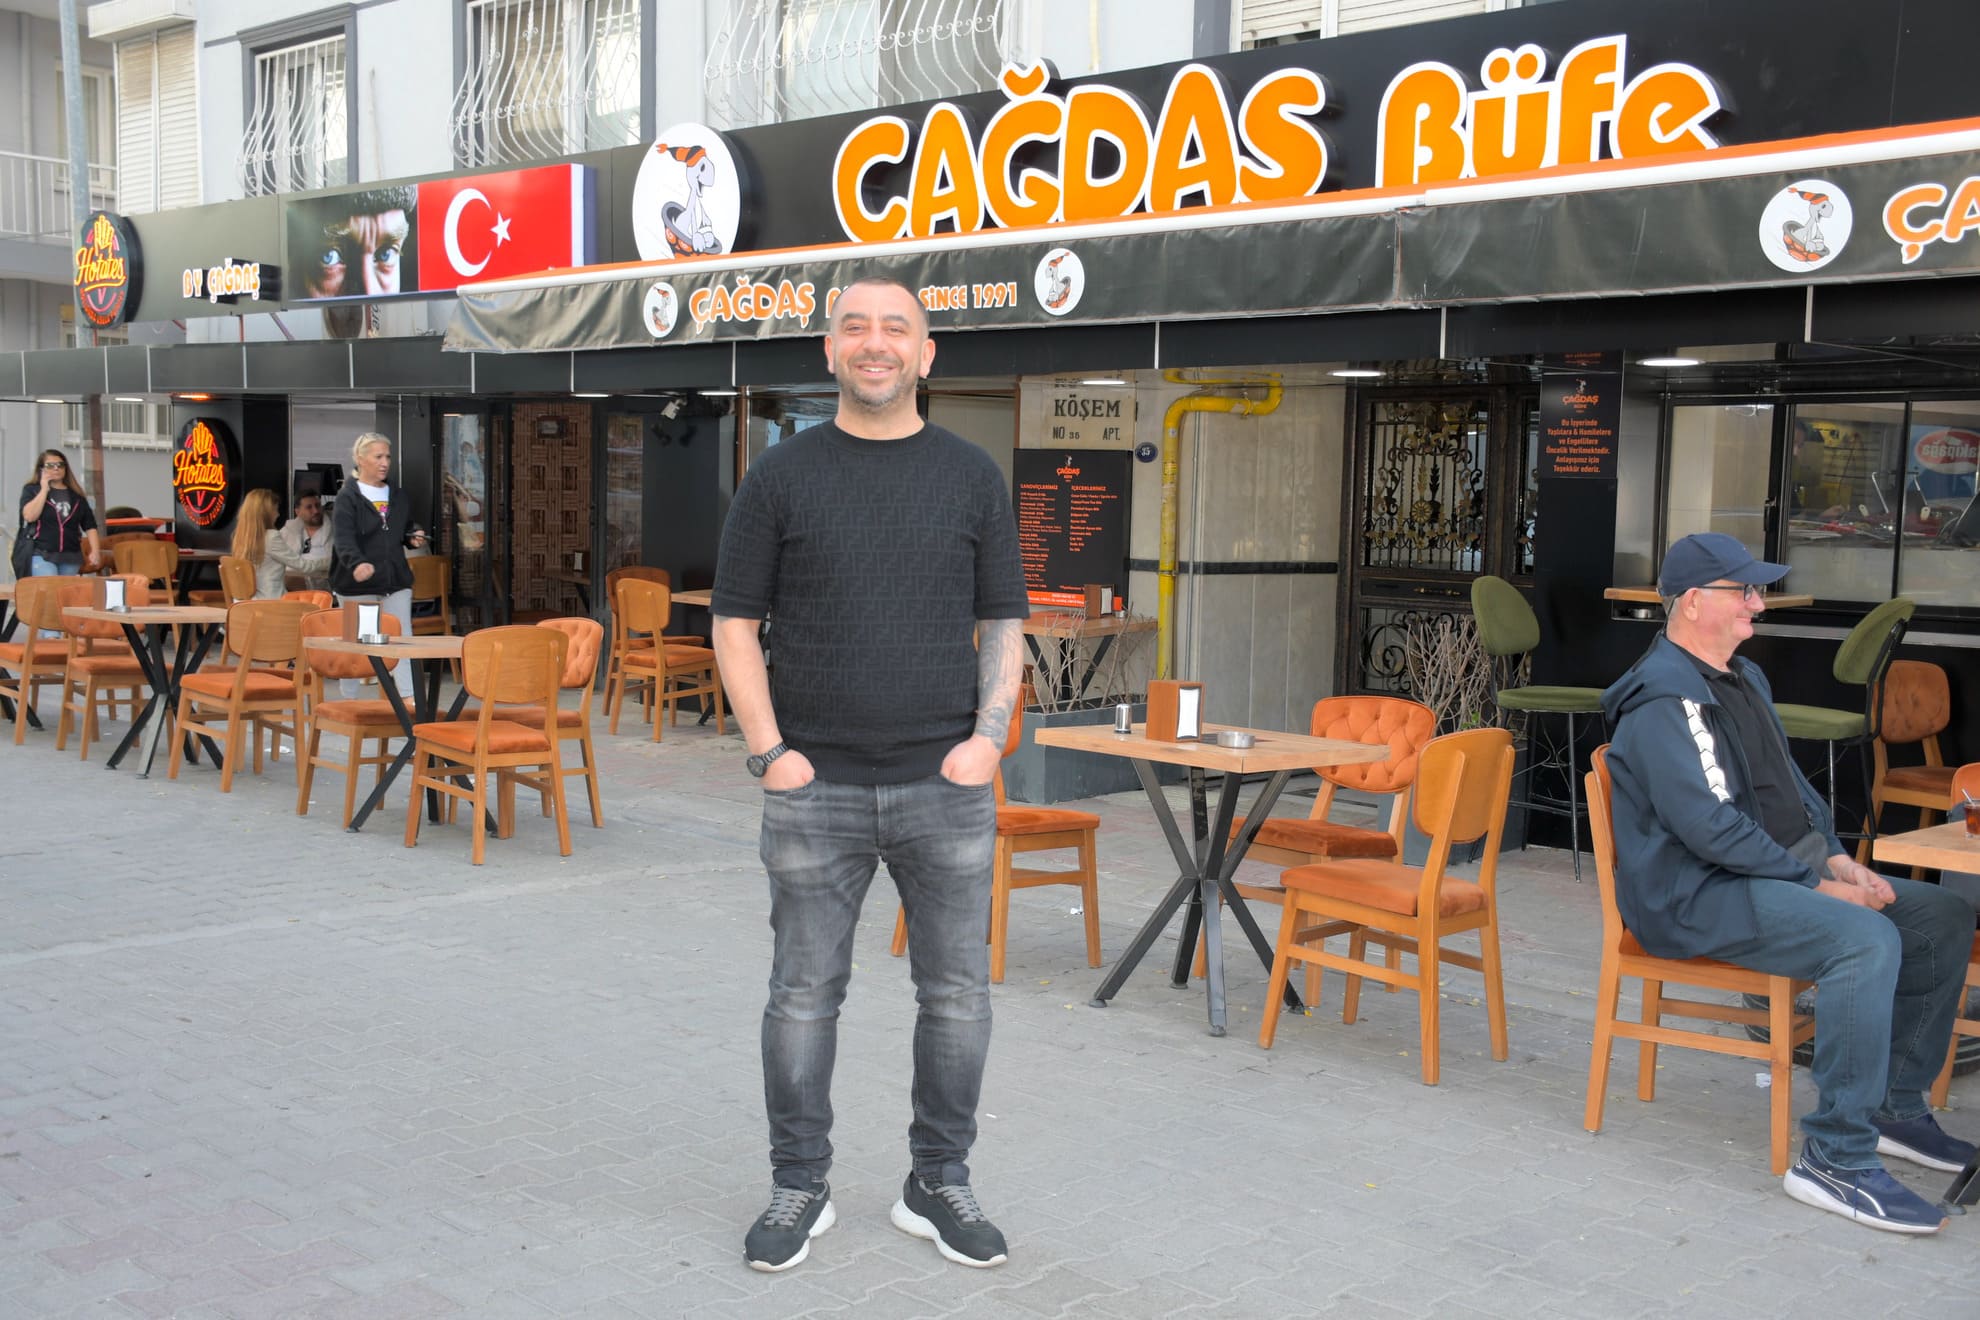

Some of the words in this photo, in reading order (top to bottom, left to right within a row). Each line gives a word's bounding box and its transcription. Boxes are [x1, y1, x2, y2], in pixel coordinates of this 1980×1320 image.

[183, 268, 203, 298] BY
[208, 258, 260, 303] ÇAĞDAŞ
[689, 275, 816, 334] ÇAĞDAŞ
[973, 281, 1018, 308] 1991
[1054, 394, 1121, 421] KÖŞEM
[172, 450, 226, 489] Hotates
